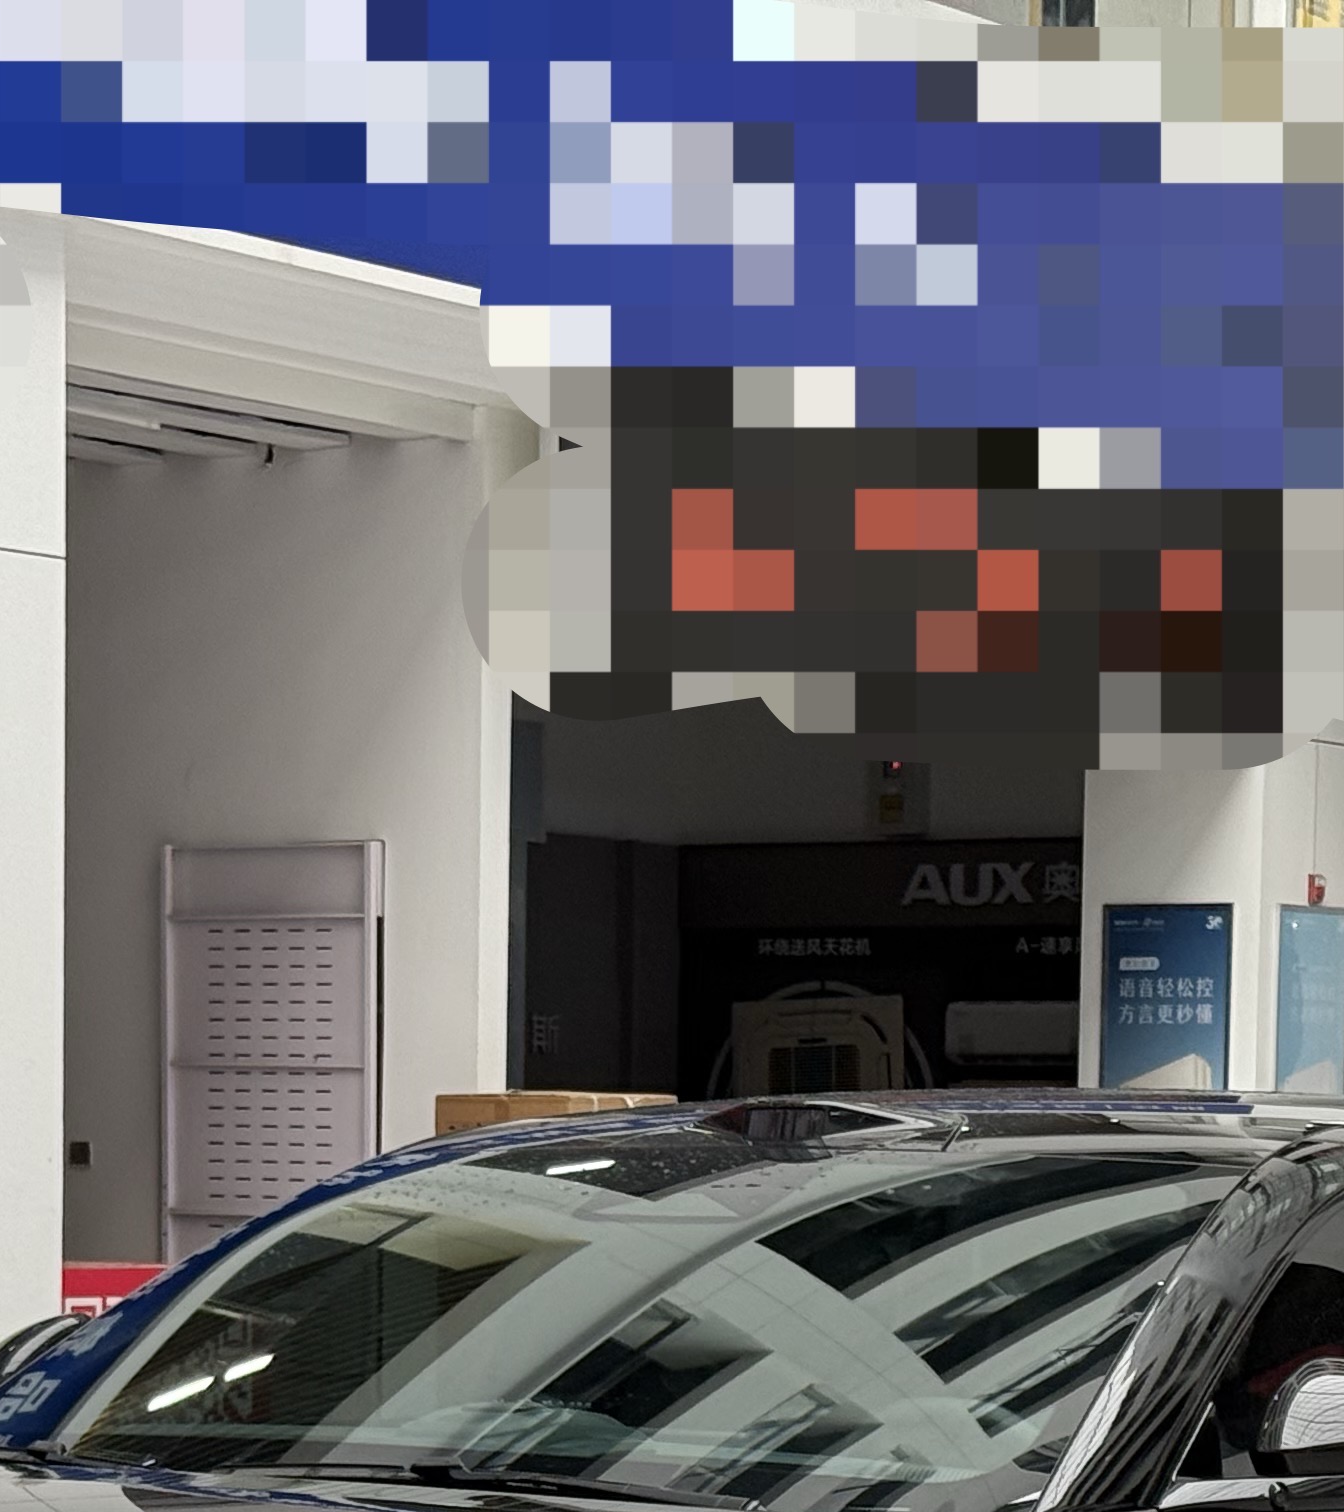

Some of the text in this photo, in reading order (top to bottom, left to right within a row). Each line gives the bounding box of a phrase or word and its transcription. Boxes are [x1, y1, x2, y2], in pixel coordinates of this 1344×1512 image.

[901, 863, 1036, 906] AUX
[1118, 977, 1214, 1000] 语音轻松控
[1118, 1003, 1214, 1026] 方言更秒懂
